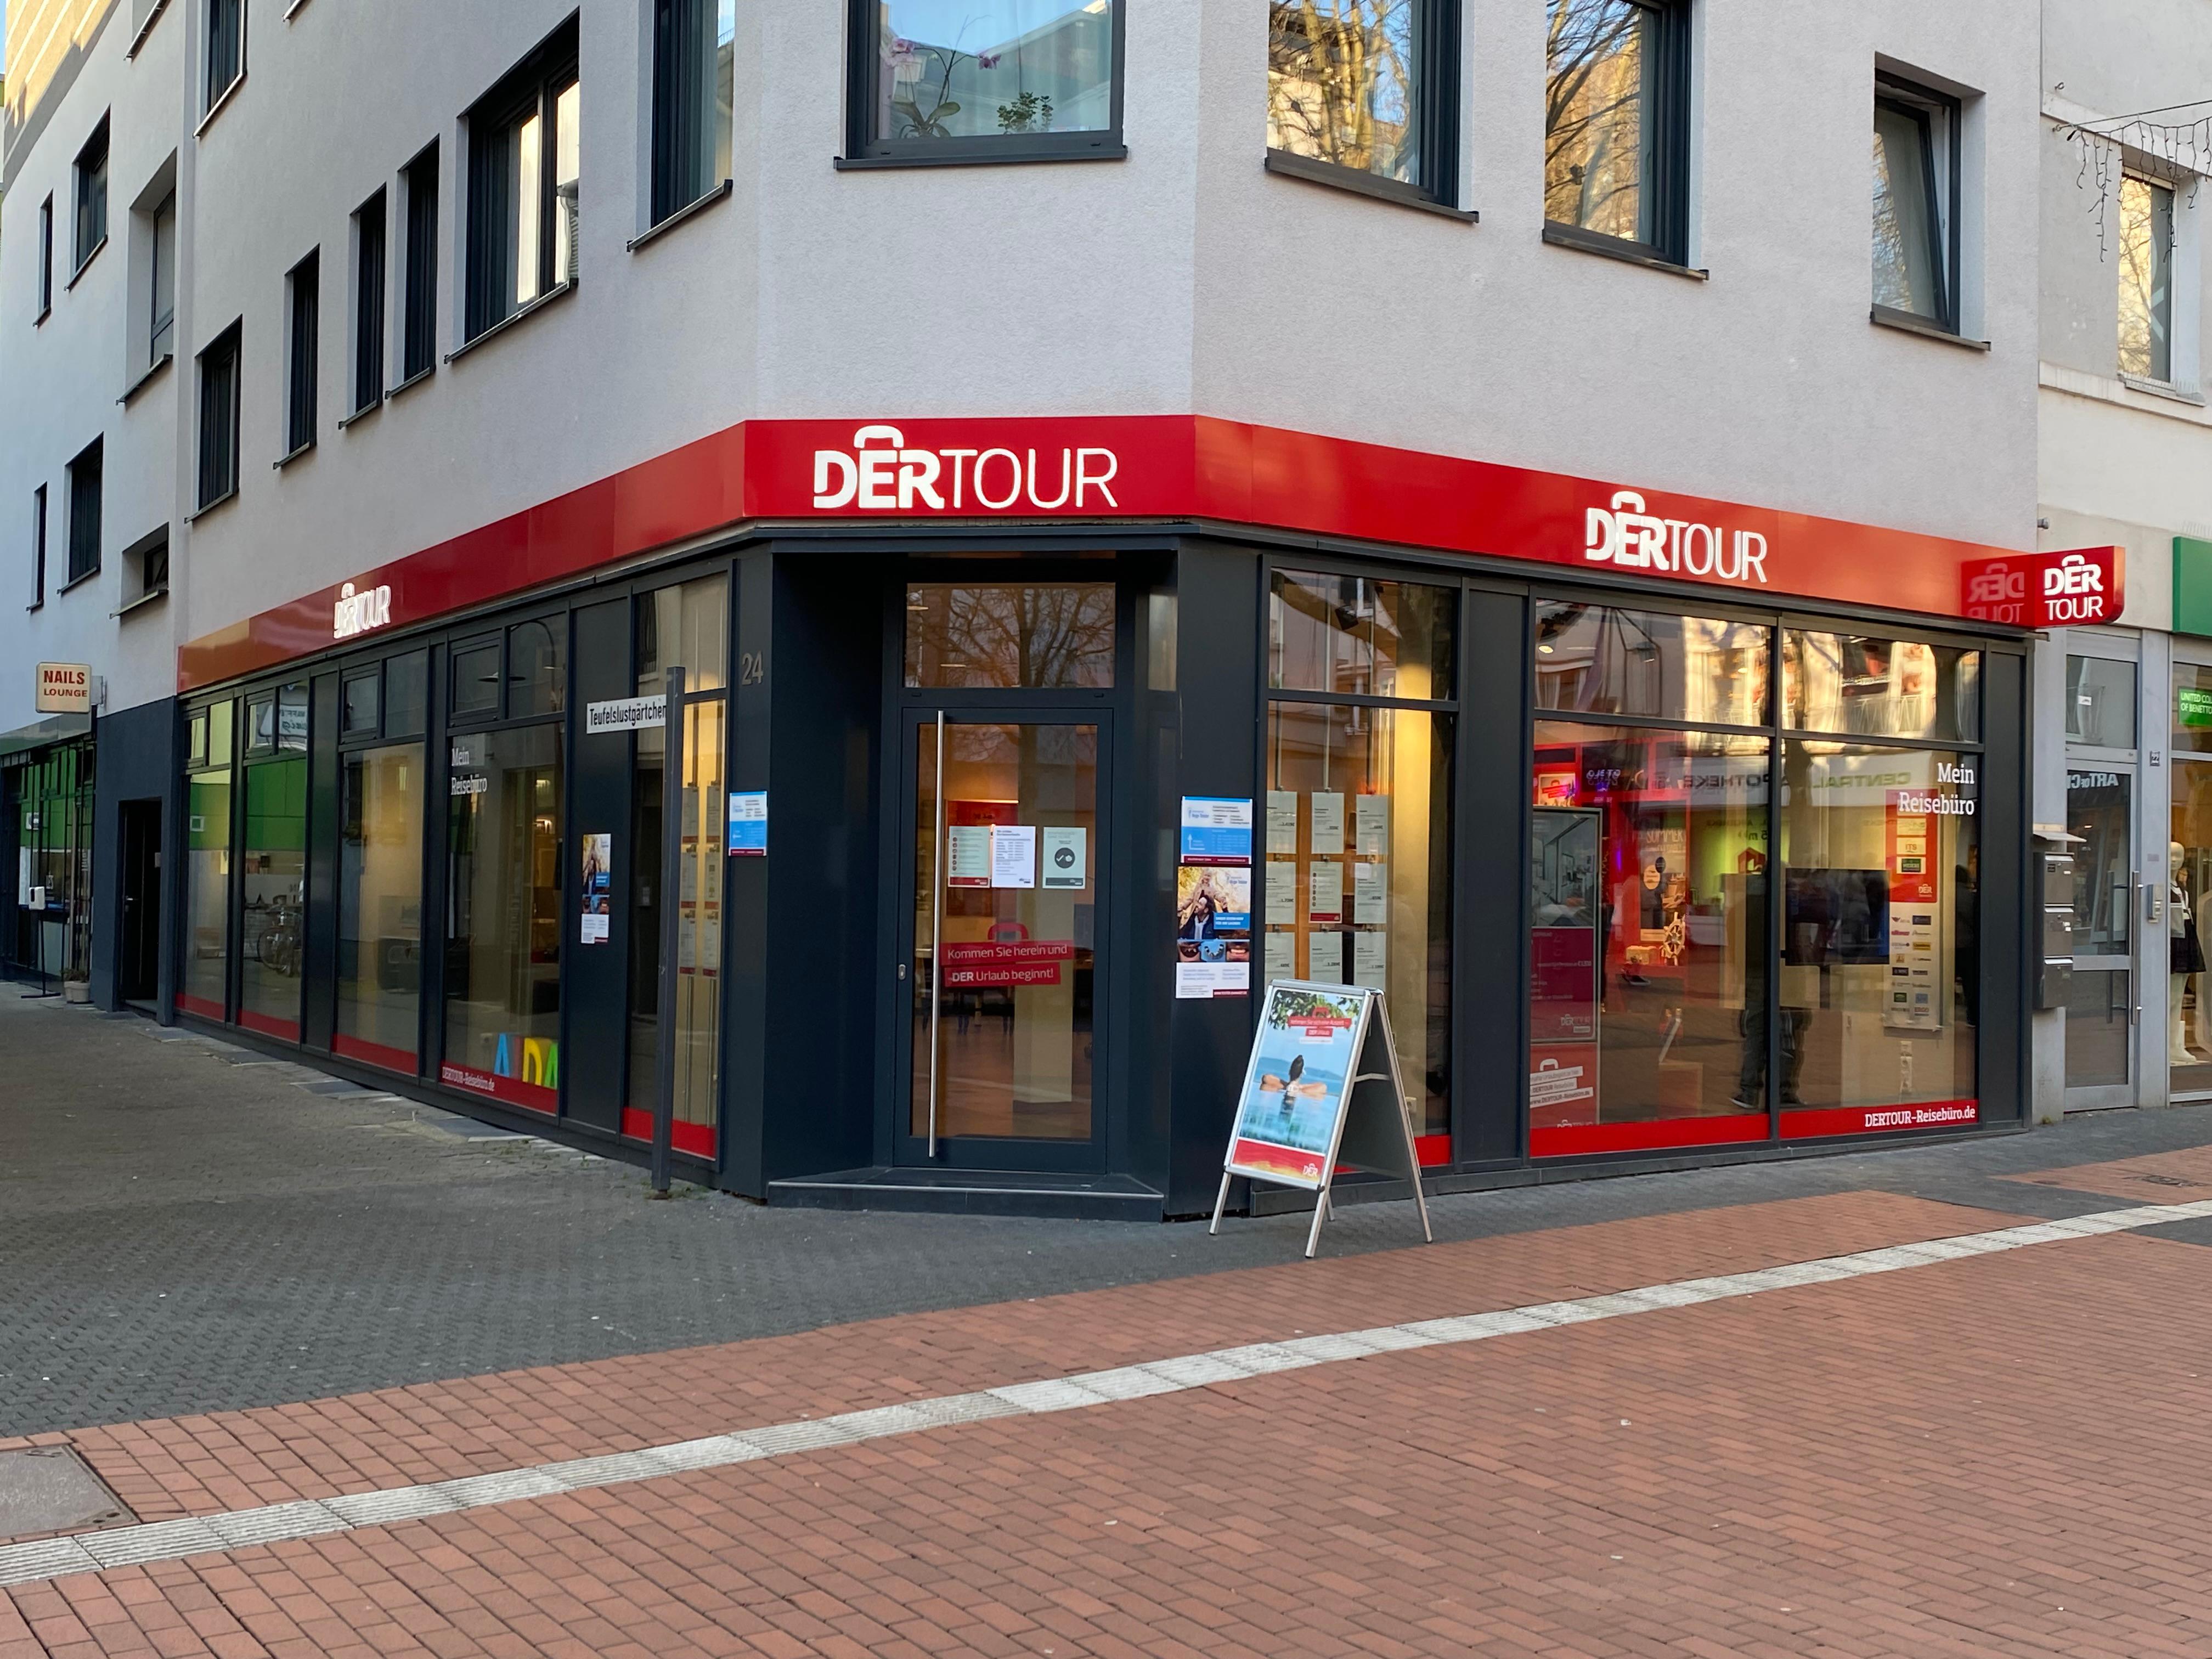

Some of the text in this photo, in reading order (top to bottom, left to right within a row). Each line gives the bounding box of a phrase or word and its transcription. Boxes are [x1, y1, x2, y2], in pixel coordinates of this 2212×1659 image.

[814, 445, 1118, 509] DERTOUR
[1585, 507, 1768, 583] DERTOUR
[2044, 564, 2103, 596] DER
[2044, 596, 2103, 620] TOUR
[44, 670, 84, 685] NAILS
[742, 651, 764, 685] 24
[44, 689, 88, 697] LOUNGE
[2181, 692, 2201, 702] UNITED
[589, 701, 667, 726] Teufelslustgärtchen
[2181, 703, 2188, 711] OF
[451, 747, 470, 766] Mein
[1937, 761, 1975, 785] Mein
[451, 774, 487, 795] Reisebüro
[1898, 792, 1975, 815] Reisebüro
[947, 944, 1068, 960] Kommen Sie herein und
[976, 970, 1010, 981] Urlaub
[1011, 968, 1054, 981] beginnt!
[494, 1033, 558, 1091] AIDA
[1865, 1105, 1976, 1127] DERTOUR-Reisebüro.de
